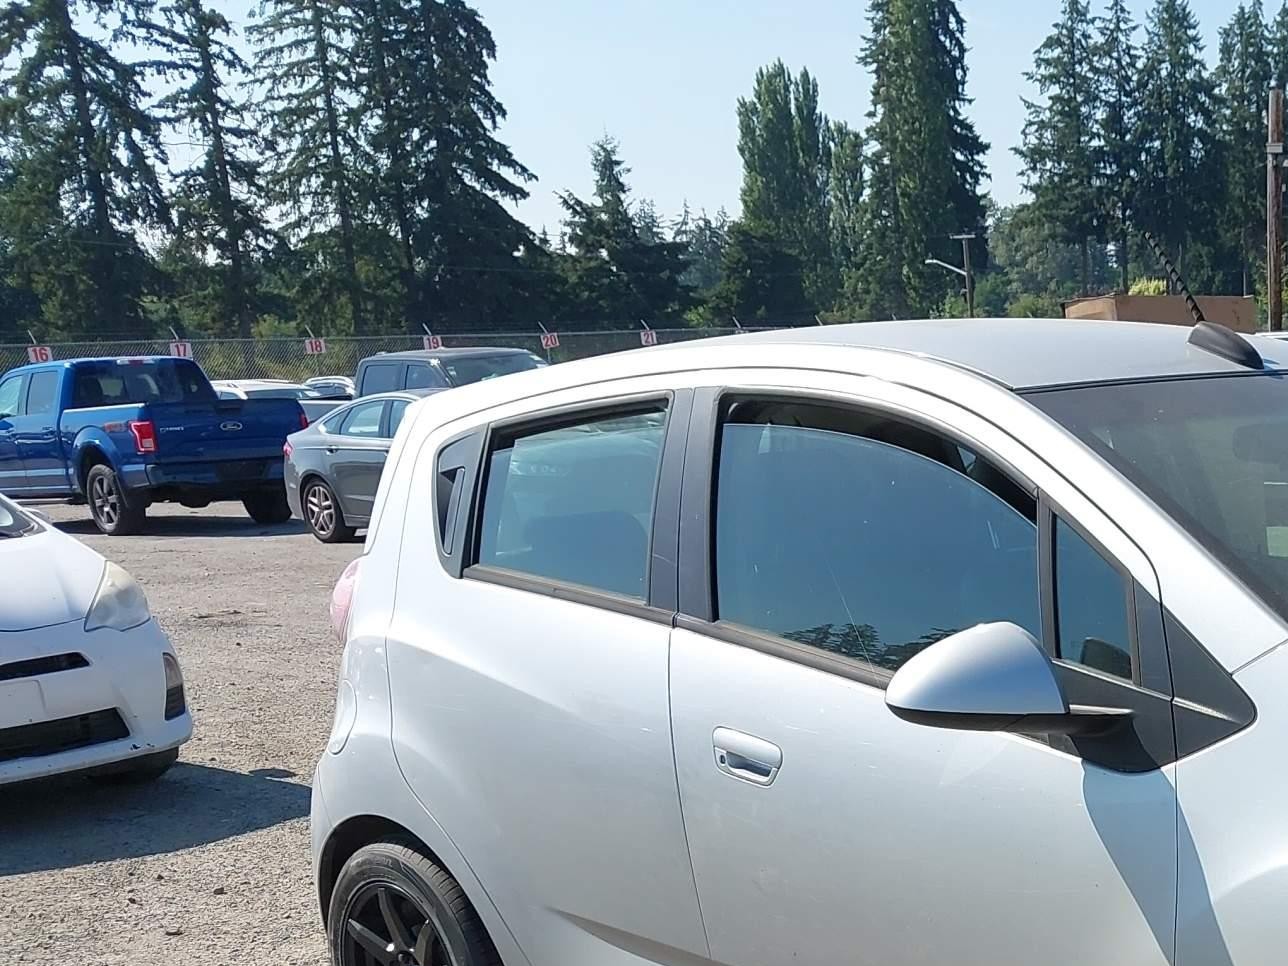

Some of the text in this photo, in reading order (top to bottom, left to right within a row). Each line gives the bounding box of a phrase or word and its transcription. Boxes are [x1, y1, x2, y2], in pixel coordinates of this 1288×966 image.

[426, 336, 440, 350] 19
[543, 335, 557, 347] 20
[643, 332, 655, 344] 21
[175, 343, 187, 357] 17
[309, 340, 323, 353] 18
[31, 347, 49, 361] 16
